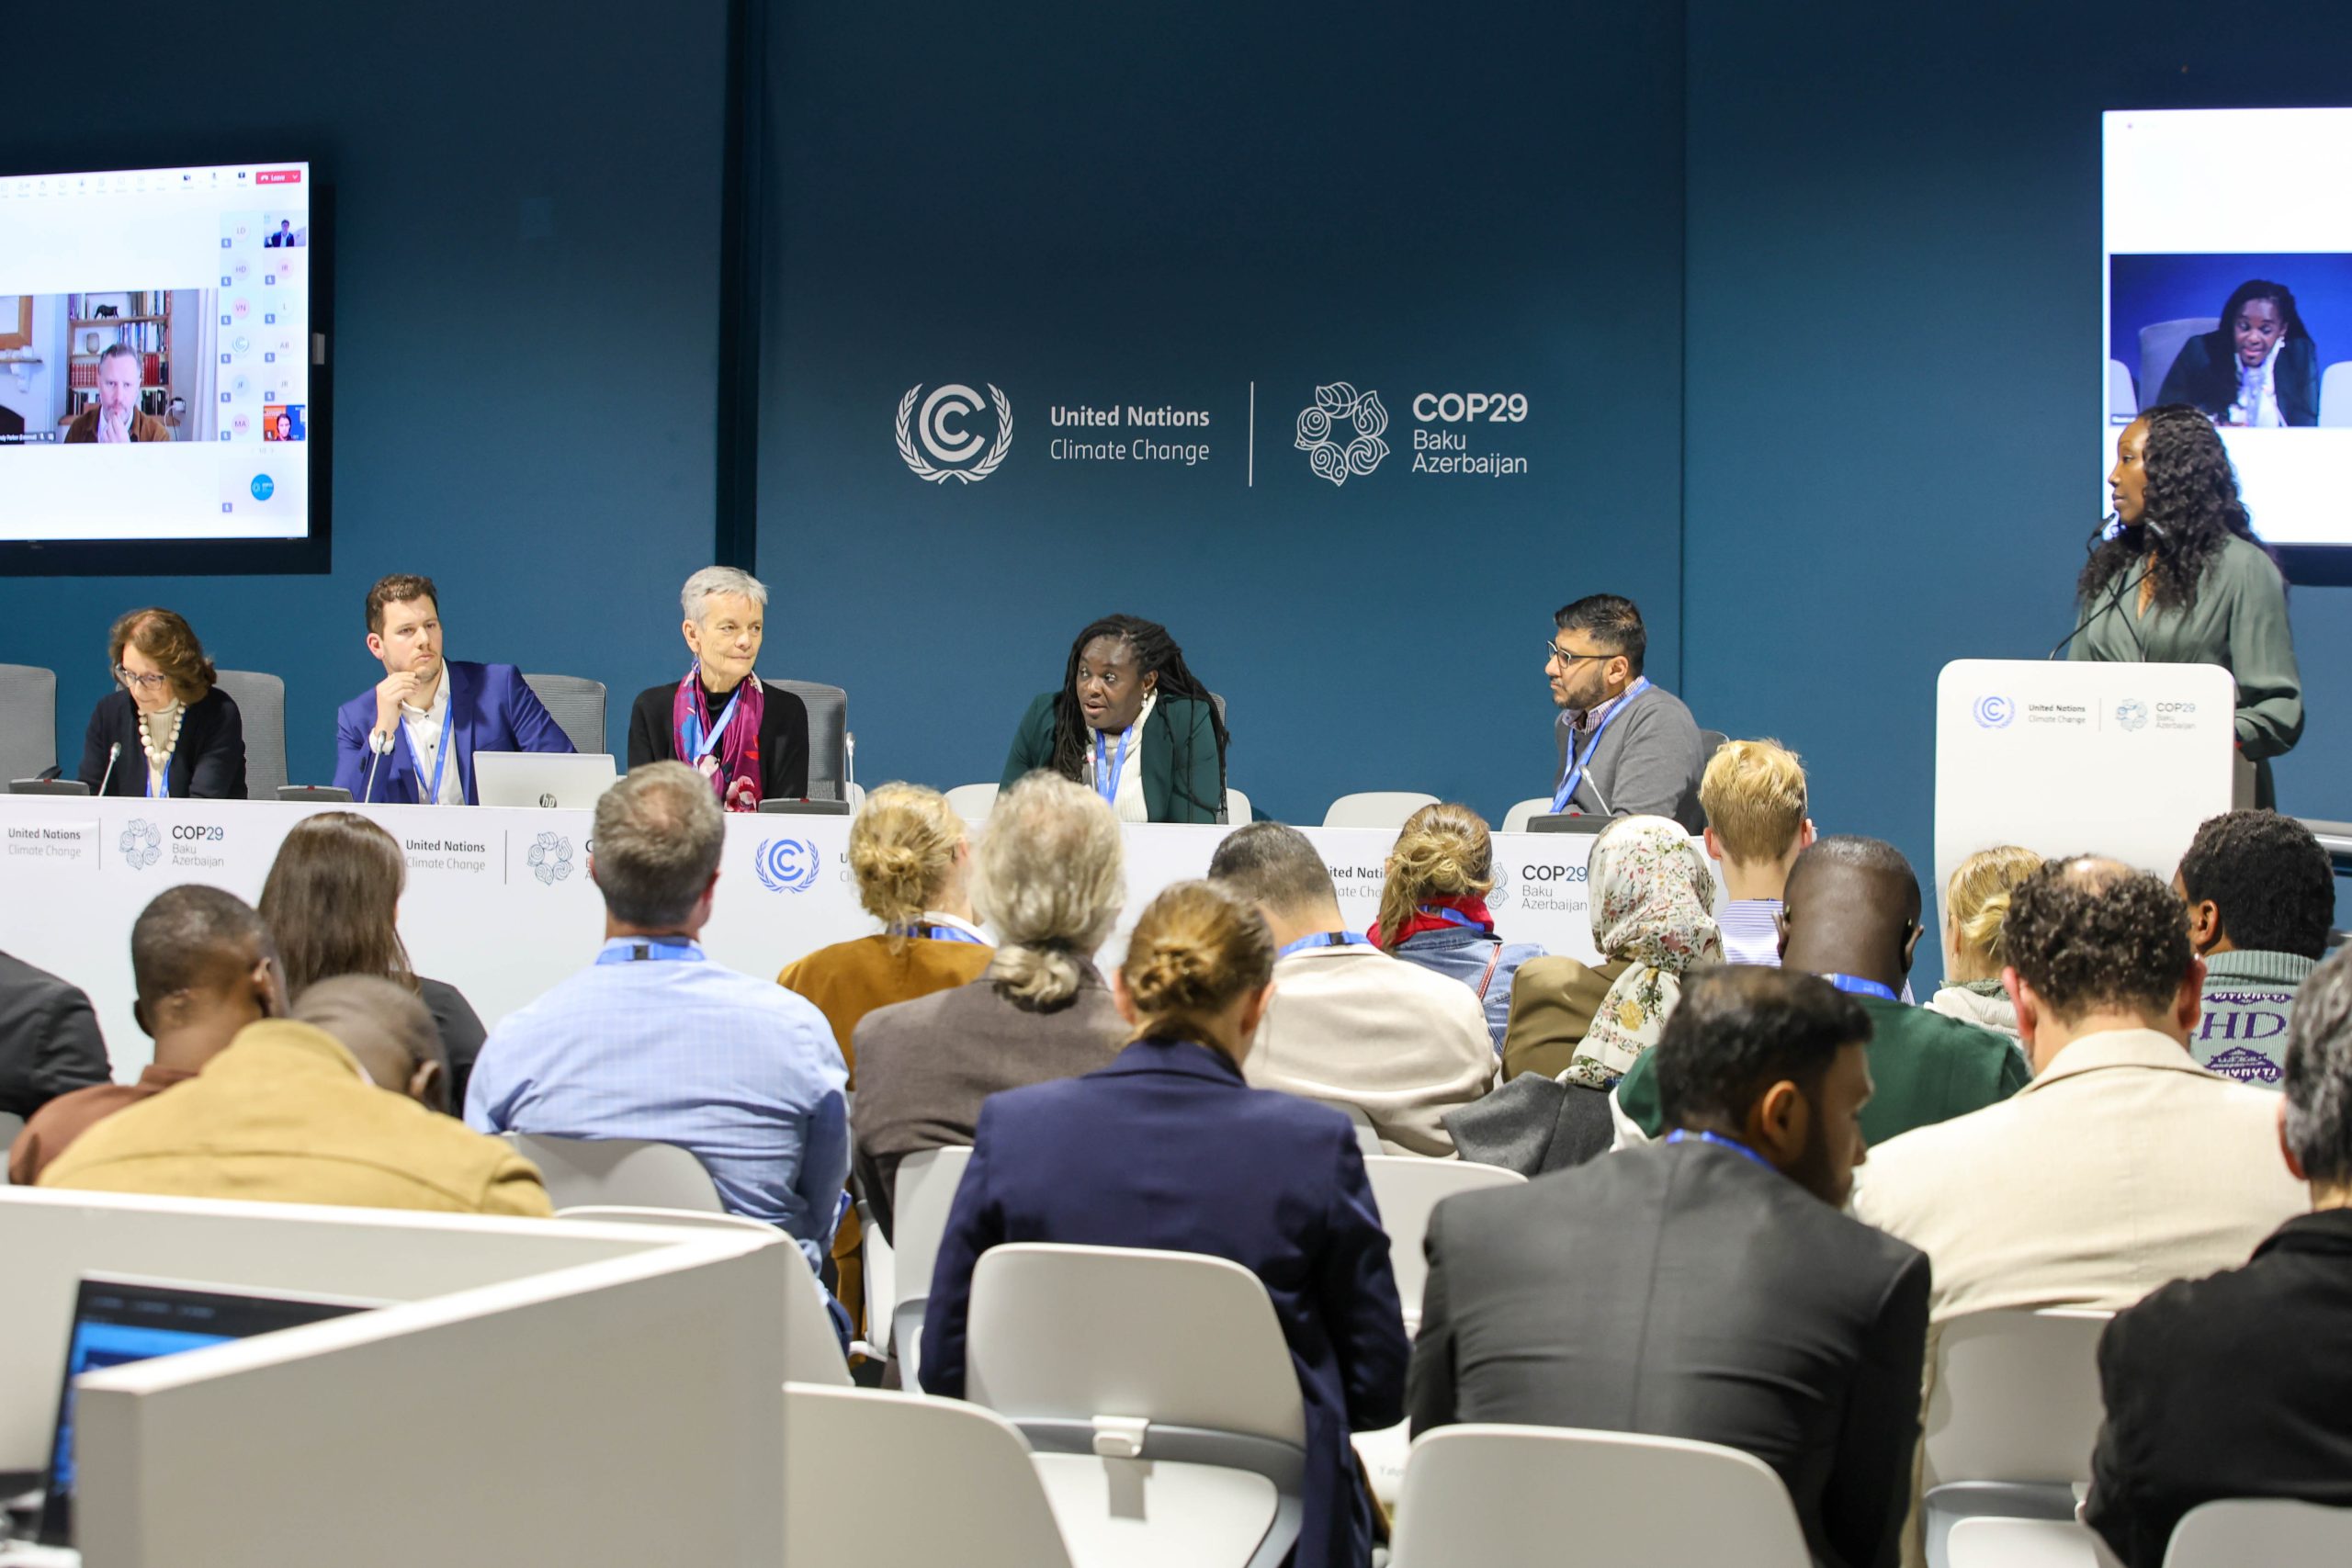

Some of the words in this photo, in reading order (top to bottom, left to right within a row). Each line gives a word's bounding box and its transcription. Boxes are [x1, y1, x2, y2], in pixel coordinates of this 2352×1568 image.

[1412, 392, 1529, 423] COP29
[1050, 404, 1120, 427] United
[1127, 405, 1210, 427] Nations
[1413, 429, 1466, 451] Baku
[1050, 438, 1126, 461] Climate
[1132, 438, 1210, 466] Change
[1411, 452, 1528, 479] Azerbaijan
[2029, 704, 2053, 712] United
[2055, 705, 2086, 713] Nations
[2155, 702, 2196, 713] COP29
[2029, 715, 2055, 723] Climate
[2057, 715, 2086, 725] Change
[541, 793, 556, 808] hp
[8, 828, 40, 839] United
[43, 829, 81, 840] Nations
[172, 825, 224, 841] COP29
[8, 843, 44, 856] Climate
[45, 844, 82, 859] Change
[172, 842, 197, 854] Baku
[406, 839, 441, 851] United
[444, 840, 486, 853] Nations
[172, 854, 224, 868] Azerbaijan
[406, 856, 445, 869] Climate
[447, 857, 486, 874] Change
[1329, 865, 1352, 879] ited
[1357, 866, 1383, 879] Nati
[1521, 864, 1589, 883] COP29
[1522, 885, 1553, 897] Baku
[1521, 897, 1588, 914] Azerbaijan
